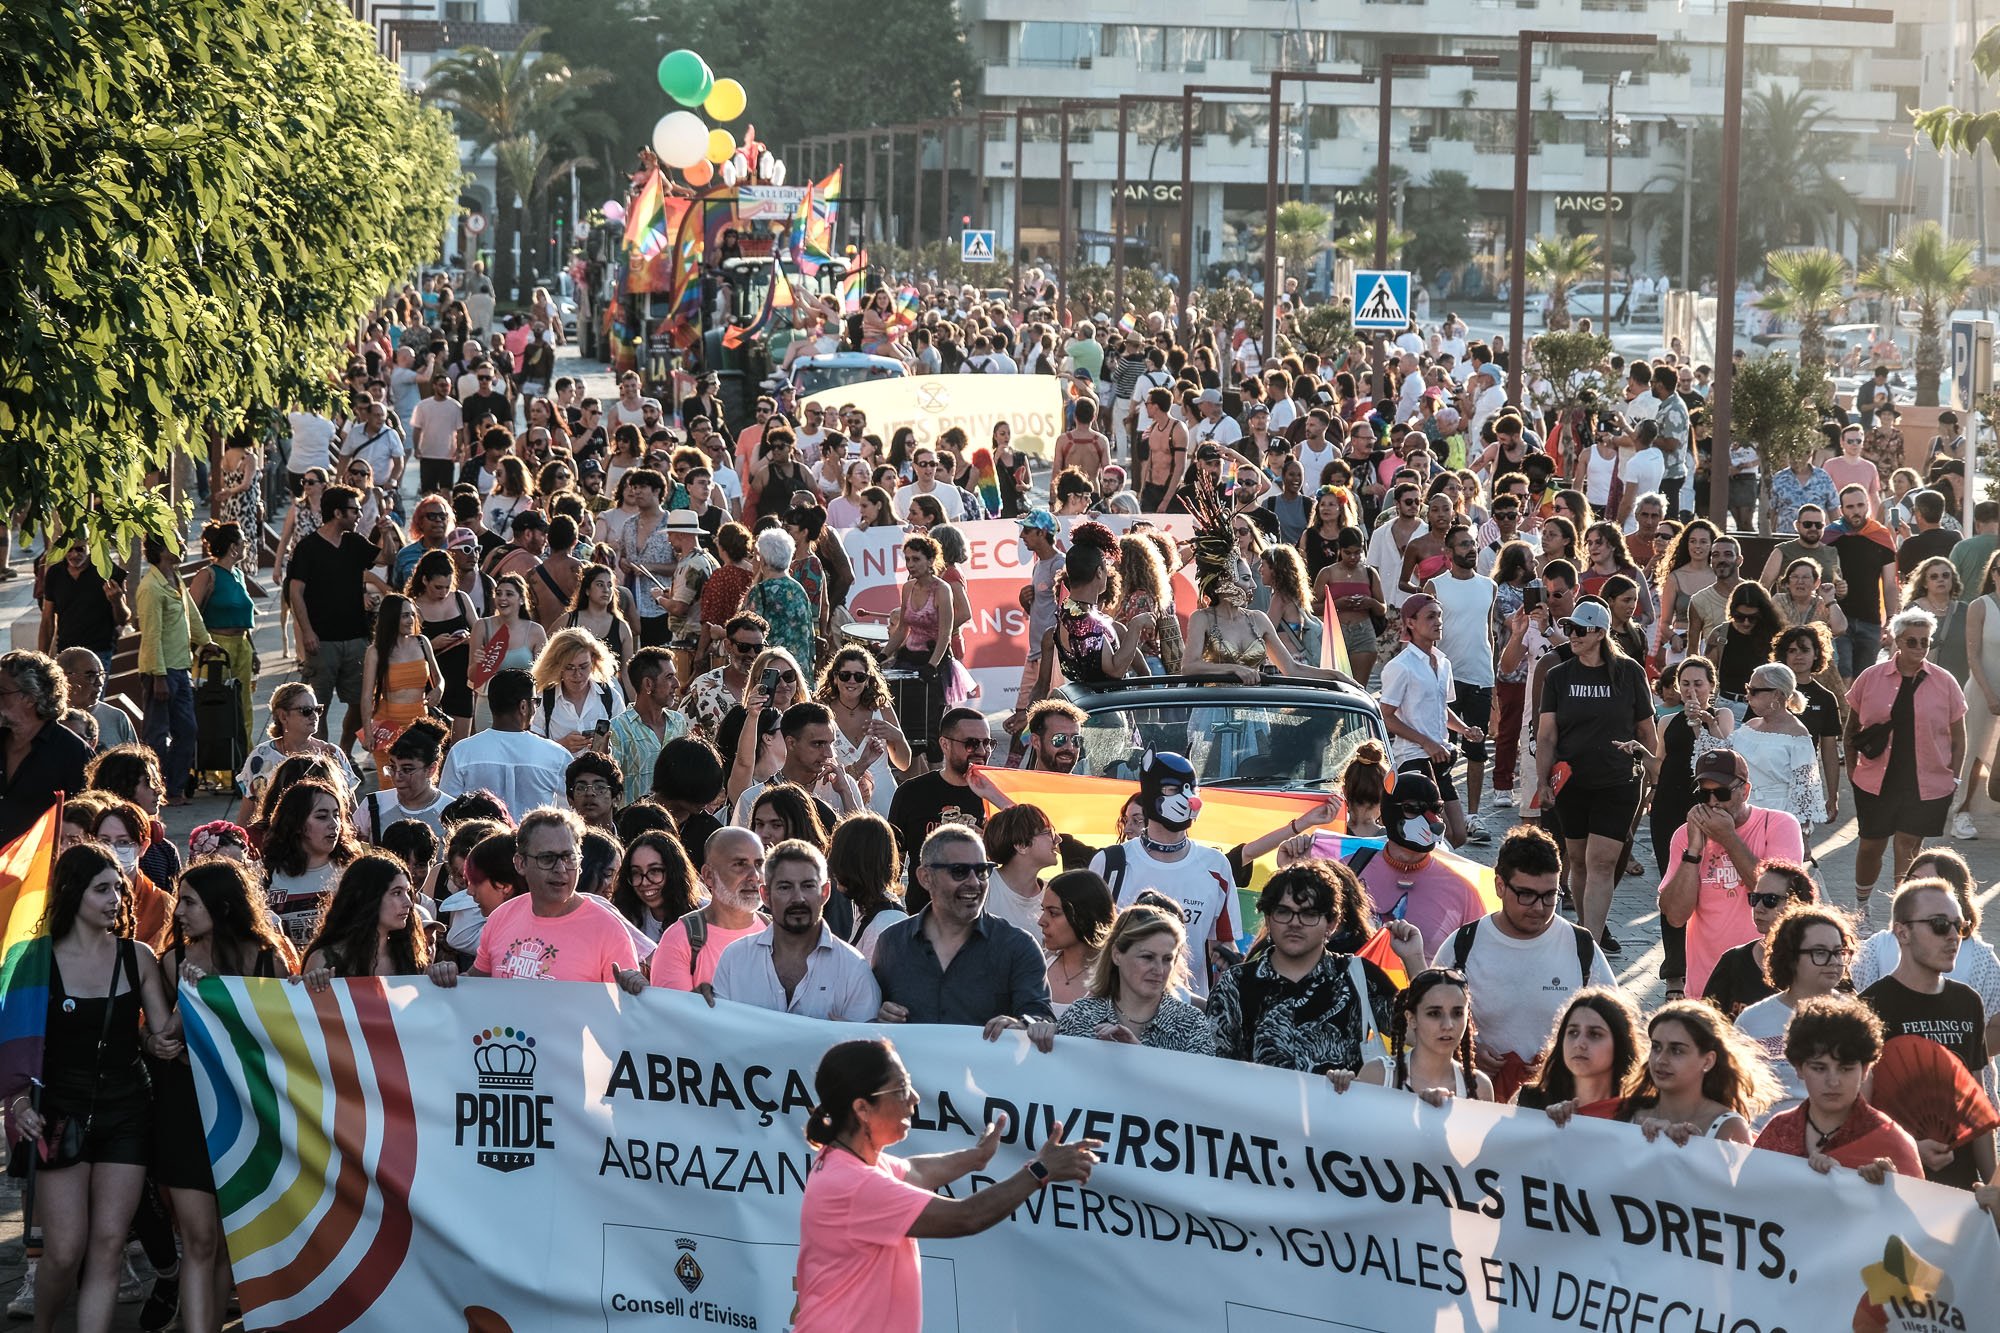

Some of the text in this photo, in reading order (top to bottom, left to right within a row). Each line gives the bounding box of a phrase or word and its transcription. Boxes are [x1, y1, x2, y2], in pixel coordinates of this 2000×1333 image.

[1111, 184, 1182, 200] ANGO
[1335, 190, 1406, 205] ANO
[1568, 684, 1611, 698] NIRVANA
[1716, 867, 1742, 884] PRID
[1183, 898, 1205, 907] FLUFFY
[1183, 908, 1203, 925] 37
[506, 955, 543, 980] PRIDE
[1902, 1020, 1974, 1034] FEELING OF
[1924, 1032, 1964, 1044] UNITY
[455, 1092, 555, 1149] PRIDE
[482, 1154, 531, 1164] IBIZA
[604, 1050, 1798, 1285] ABRAÇA LA DIVERSITAT: IGUALS EN DRETS.
[598, 1136, 1789, 1333] ABRAZAN VERSIDAD: IGUALES EN DERECH
[611, 1293, 758, 1331] Consell d'Eivissa
[1889, 1293, 1966, 1331] Ibiza
